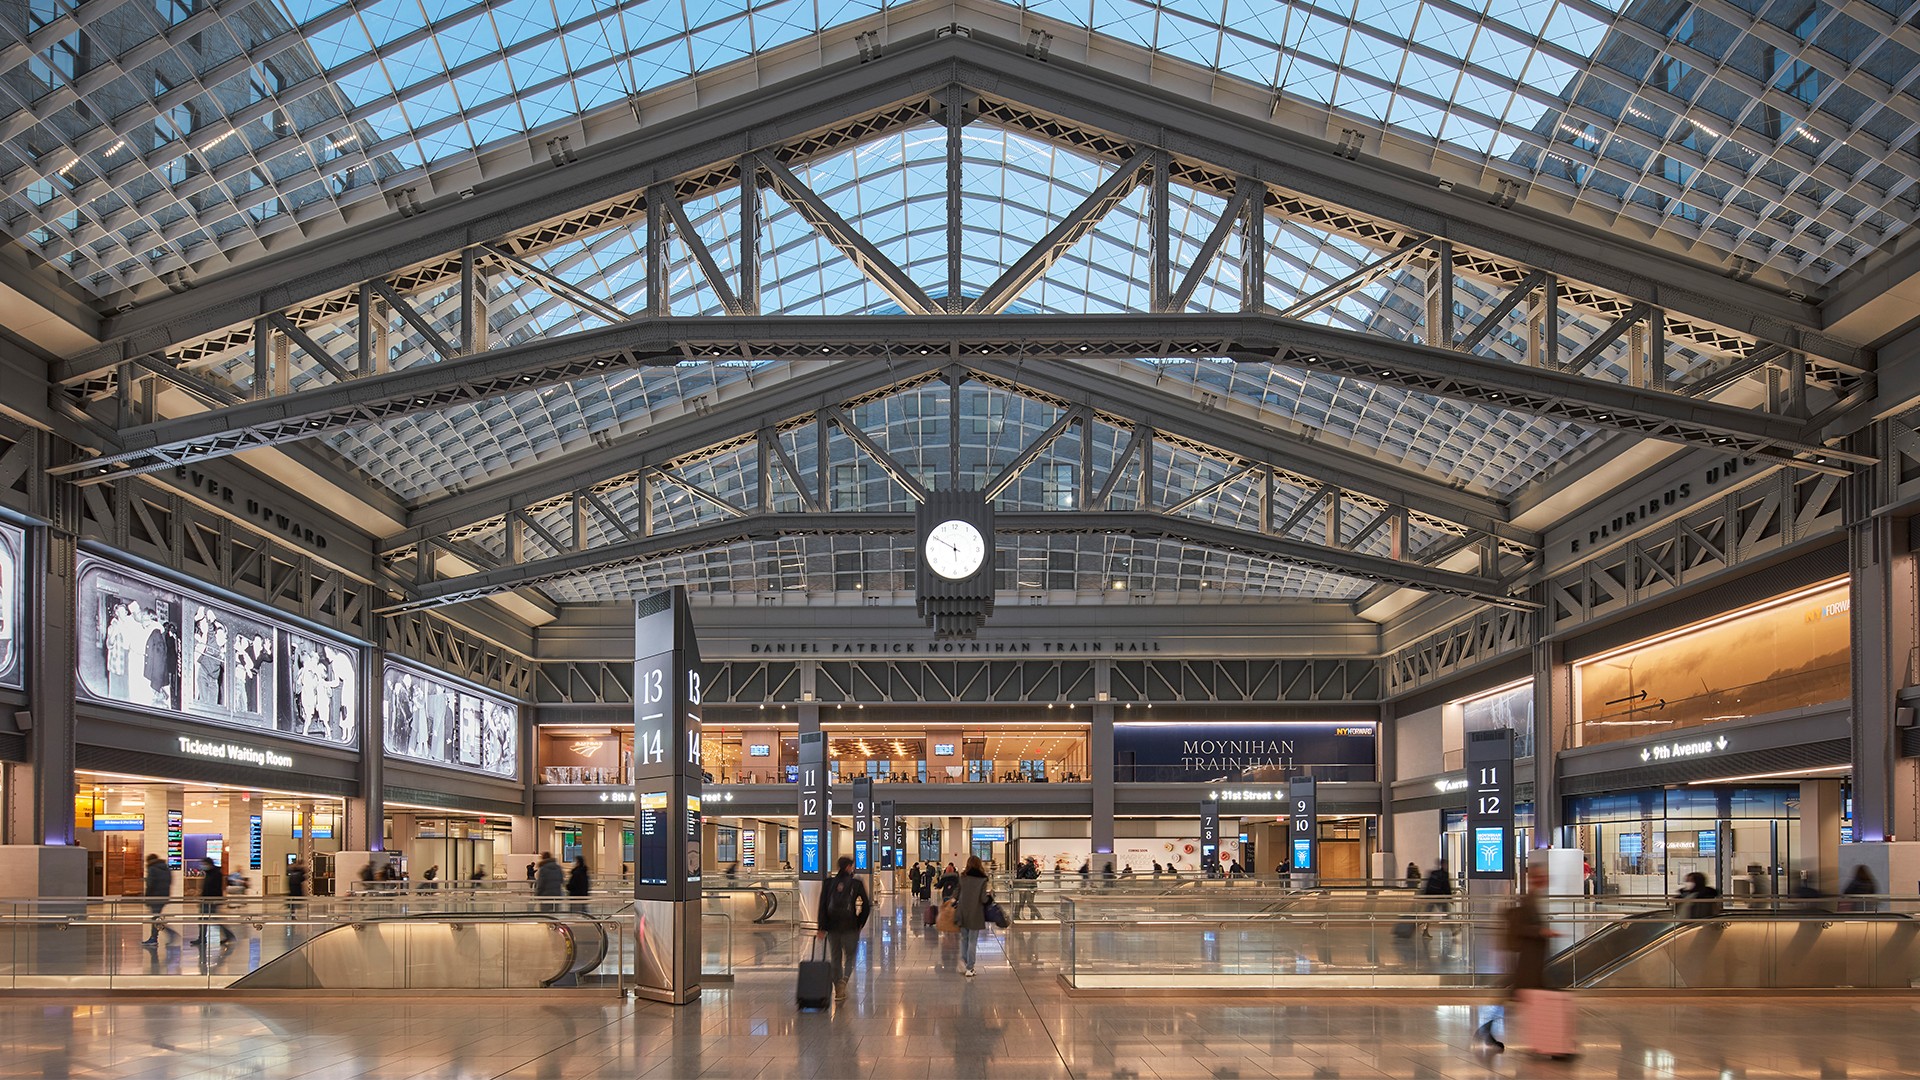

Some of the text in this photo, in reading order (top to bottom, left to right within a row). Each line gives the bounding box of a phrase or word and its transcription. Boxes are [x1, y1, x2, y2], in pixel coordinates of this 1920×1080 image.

[175, 464, 327, 549] EVER UPWARD
[1571, 457, 1756, 553] E PLURIBUS UN
[1826, 599, 1850, 616] FORWA
[751, 643, 1160, 653] DANIEL PATRICK MOYNIHAN TRAIN HALL
[643, 669, 663, 705] 13
[688, 669, 700, 706] 13
[178, 736, 292, 768] Ticketed Waiting Room
[642, 729, 663, 765] 14
[688, 729, 700, 765] 14
[1183, 740, 1294, 755] MOYNIHAN
[1653, 740, 1713, 760] 9th Avenue
[1181, 757, 1297, 771] TRAIN HALL
[805, 769, 815, 786] 11
[1480, 767, 1498, 785] 11
[1447, 780, 1468, 790] AMTR
[612, 792, 627, 802] 8th
[701, 793, 721, 802] reet
[1221, 790, 1272, 800] 31st Street
[803, 799, 817, 816] 12
[857, 801, 864, 813] 9
[1297, 800, 1306, 812] 9
[1479, 796, 1500, 814] 12
[856, 820, 866, 832] 10
[884, 818, 889, 826] 7
[1205, 817, 1212, 826] 7
[1295, 820, 1308, 832] 10
[884, 831, 889, 840] 8
[1205, 831, 1212, 840] 8
